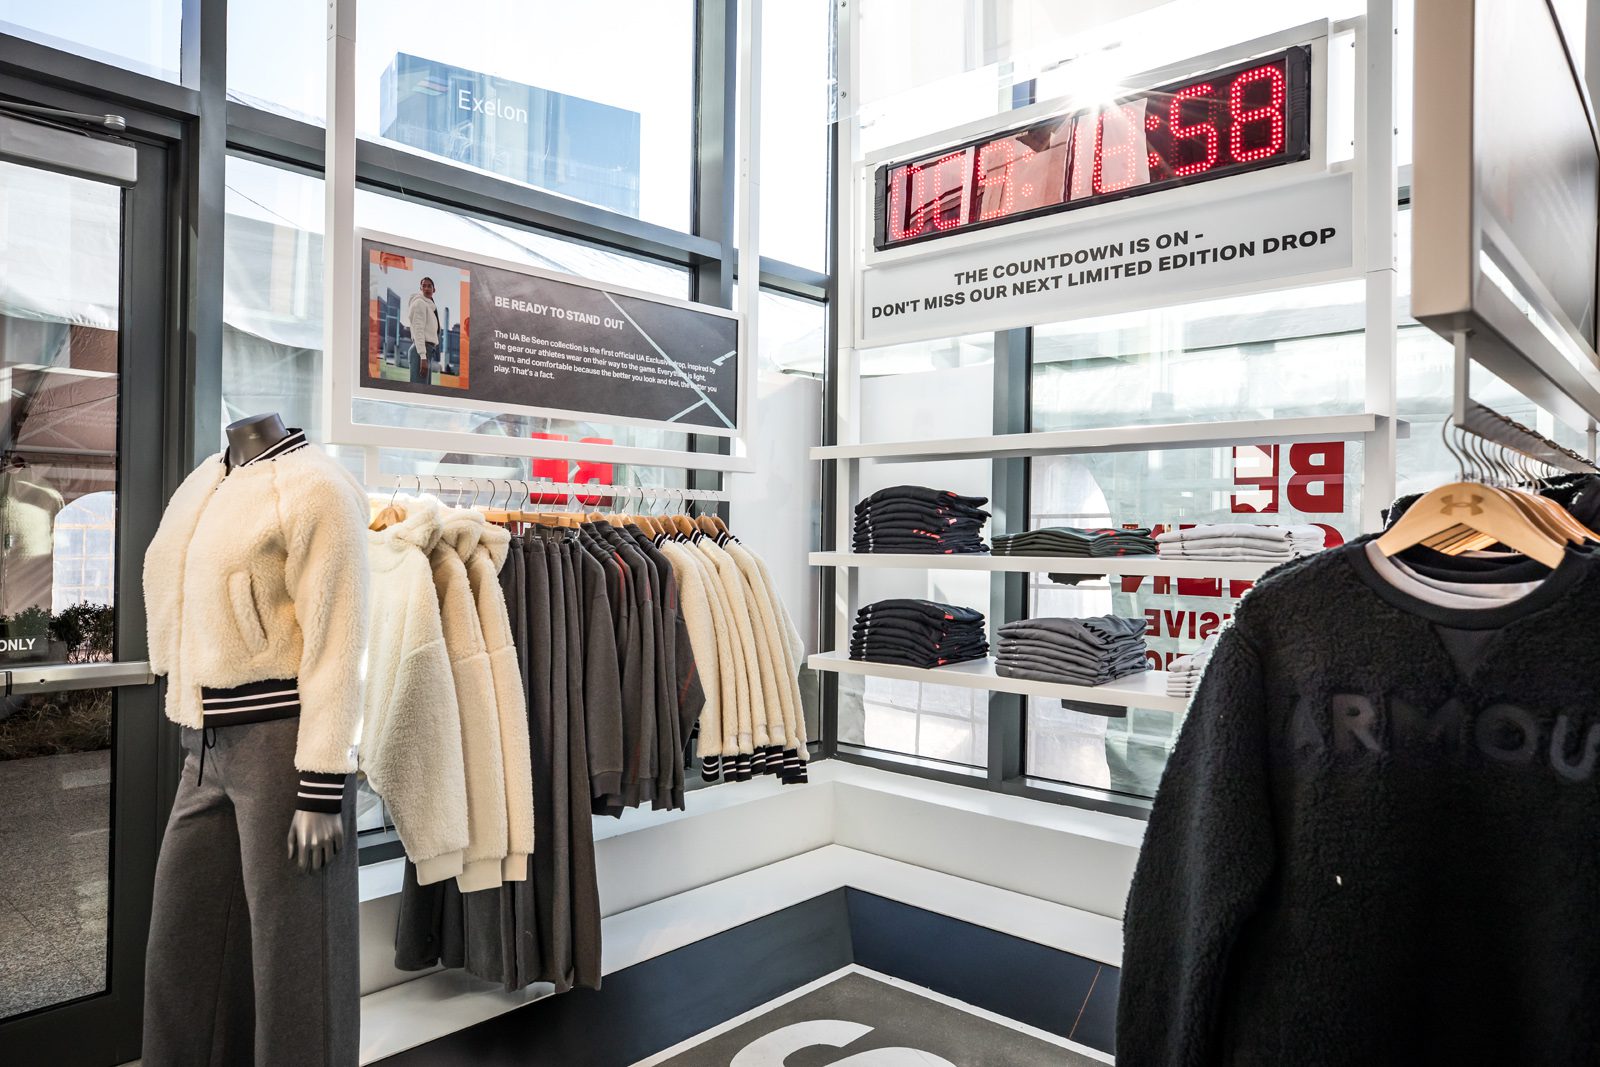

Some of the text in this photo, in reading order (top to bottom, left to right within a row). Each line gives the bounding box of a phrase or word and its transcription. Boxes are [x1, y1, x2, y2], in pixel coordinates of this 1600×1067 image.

[458, 88, 528, 125] Exelon
[871, 227, 1336, 319] DON'T MISS OUR NEXT LIMITED EDITION DROP
[954, 267, 988, 286] THE
[992, 243, 1124, 280] COUNTDOWN
[1129, 237, 1150, 255] IS
[1156, 230, 1189, 250] ON
[494, 295, 625, 330] BE READY TO STAND OUT
[494, 329, 508, 340] The
[509, 332, 520, 342] UA
[521, 334, 530, 343] Be
[531, 336, 549, 346] Seen
[550, 340, 582, 352] collection
[583, 344, 589, 353] is
[589, 345, 600, 355] the
[601, 347, 614, 357] first
[614, 348, 636, 360] official
[636, 353, 645, 362] UA
[687, 361, 709, 374] inspired
[709, 366, 716, 375] by
[494, 341, 506, 350] the
[507, 344, 524, 353] gear
[524, 346, 537, 355] our
[538, 348, 565, 360] athletes
[566, 354, 582, 362] wear
[583, 356, 592, 364] on
[592, 357, 607, 367] their
[608, 360, 620, 369] way
[621, 361, 627, 369] to
[628, 362, 639, 371] the
[639, 365, 656, 373] game.
[494, 364, 511, 374] play.
[511, 366, 533, 377] That's
[539, 370, 555, 379] fact.
[494, 354, 516, 363] warm,
[517, 356, 531, 365] and
[531, 359, 573, 372] comfortable
[573, 364, 600, 375] because
[600, 368, 611, 377] the
[612, 370, 631, 380] better
[631, 374, 643, 382] you
[643, 374, 656, 384] look
[656, 377, 668, 385] and
[668, 378, 680, 388] feel,
[707, 384, 717, 393] you
